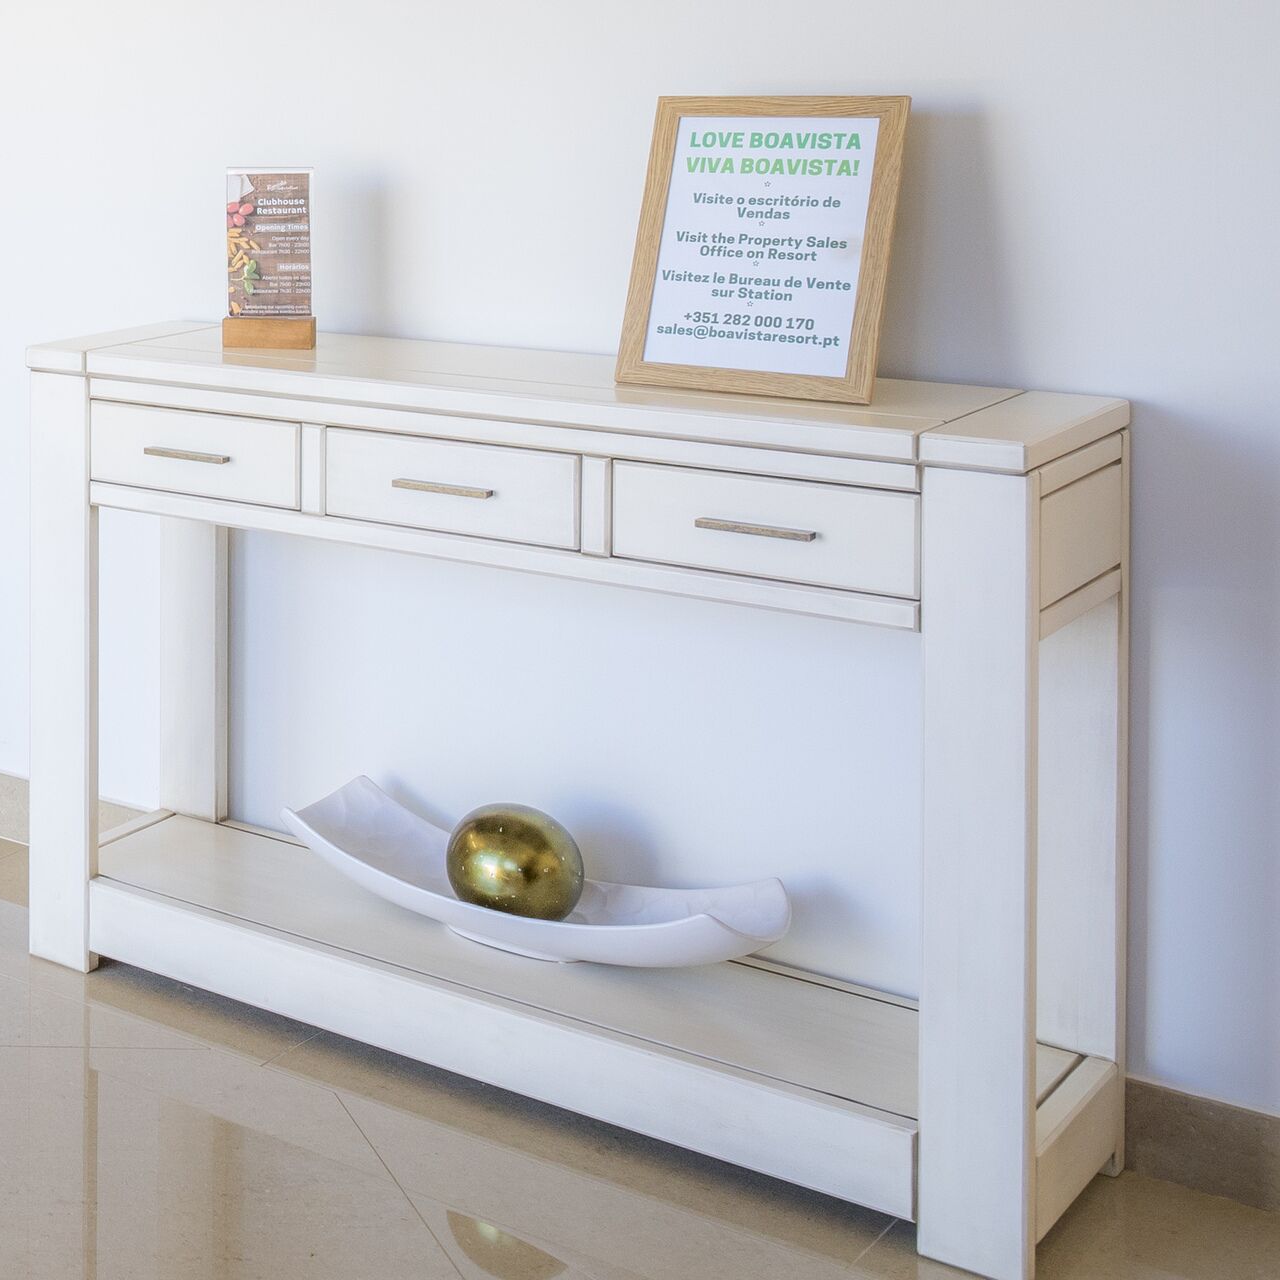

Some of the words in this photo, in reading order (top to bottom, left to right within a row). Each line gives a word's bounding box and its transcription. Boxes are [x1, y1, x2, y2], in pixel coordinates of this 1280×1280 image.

[689, 131, 746, 149] LOVE
[749, 131, 862, 150] BOAVISTA
[686, 156, 735, 174] VIVA
[739, 158, 861, 177] BOAVISTA!
[257, 198, 305, 206] Clubhouse
[693, 192, 734, 205] Visite
[736, 196, 746, 206] o
[747, 194, 820, 208] escritório
[822, 195, 842, 209] de
[256, 207, 307, 215] Restaurant
[736, 206, 791, 220] Vendas
[255, 224, 287, 233] Opening
[287, 223, 309, 231] Times
[676, 230, 709, 244] Visit
[711, 231, 736, 245] the
[737, 233, 804, 250] Property
[805, 235, 848, 250] Sales
[699, 244, 744, 259] Office
[746, 249, 765, 260] on
[767, 247, 818, 262] Resort
[661, 269, 711, 284] Visitez
[712, 271, 726, 285] le
[728, 272, 781, 287] Bureau
[783, 275, 803, 289] de
[806, 276, 852, 291] Vente
[711, 288, 736, 298] sur
[737, 286, 793, 302] Station
[683, 310, 720, 325] +351
[722, 313, 751, 327] 282
[753, 315, 783, 329] 000
[785, 317, 815, 331] 170
[656, 323, 841, 349] sales@boavistaresort.pt
